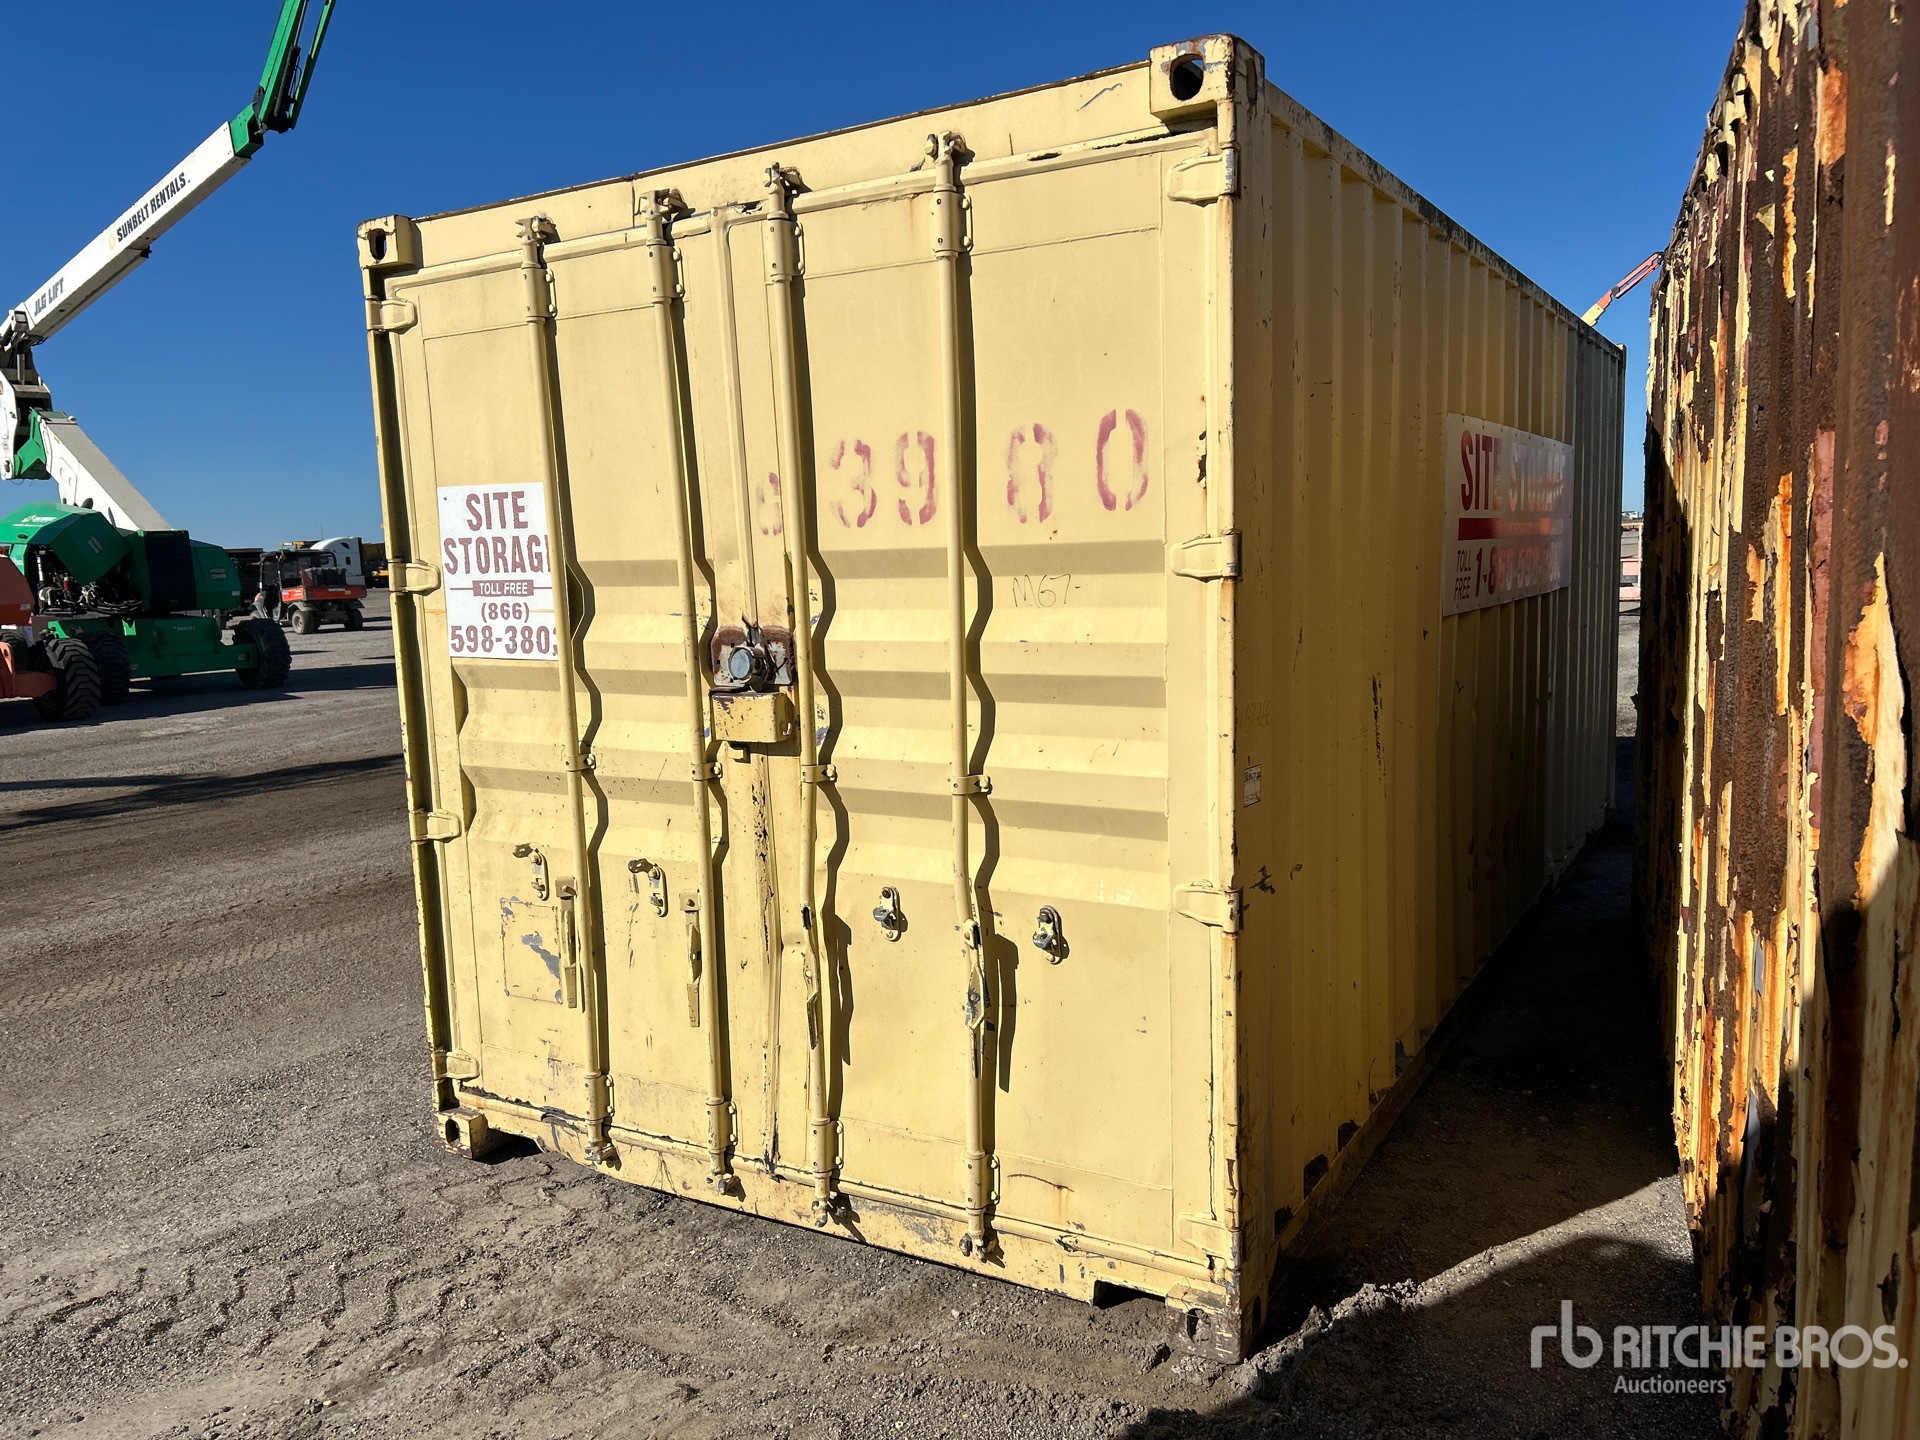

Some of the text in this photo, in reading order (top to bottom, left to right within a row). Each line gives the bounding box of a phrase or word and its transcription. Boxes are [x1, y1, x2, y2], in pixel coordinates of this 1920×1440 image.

[116, 203, 149, 242] SUNBELT
[34, 277, 64, 317] JLG LIFT
[1461, 430, 1502, 511] SITE
[465, 490, 529, 531] SITE
[1456, 549, 1471, 572] TOLL
[479, 582, 528, 595] TOLL FREE
[1453, 576, 1471, 601] FREE
[481, 602, 530, 623] (866)
